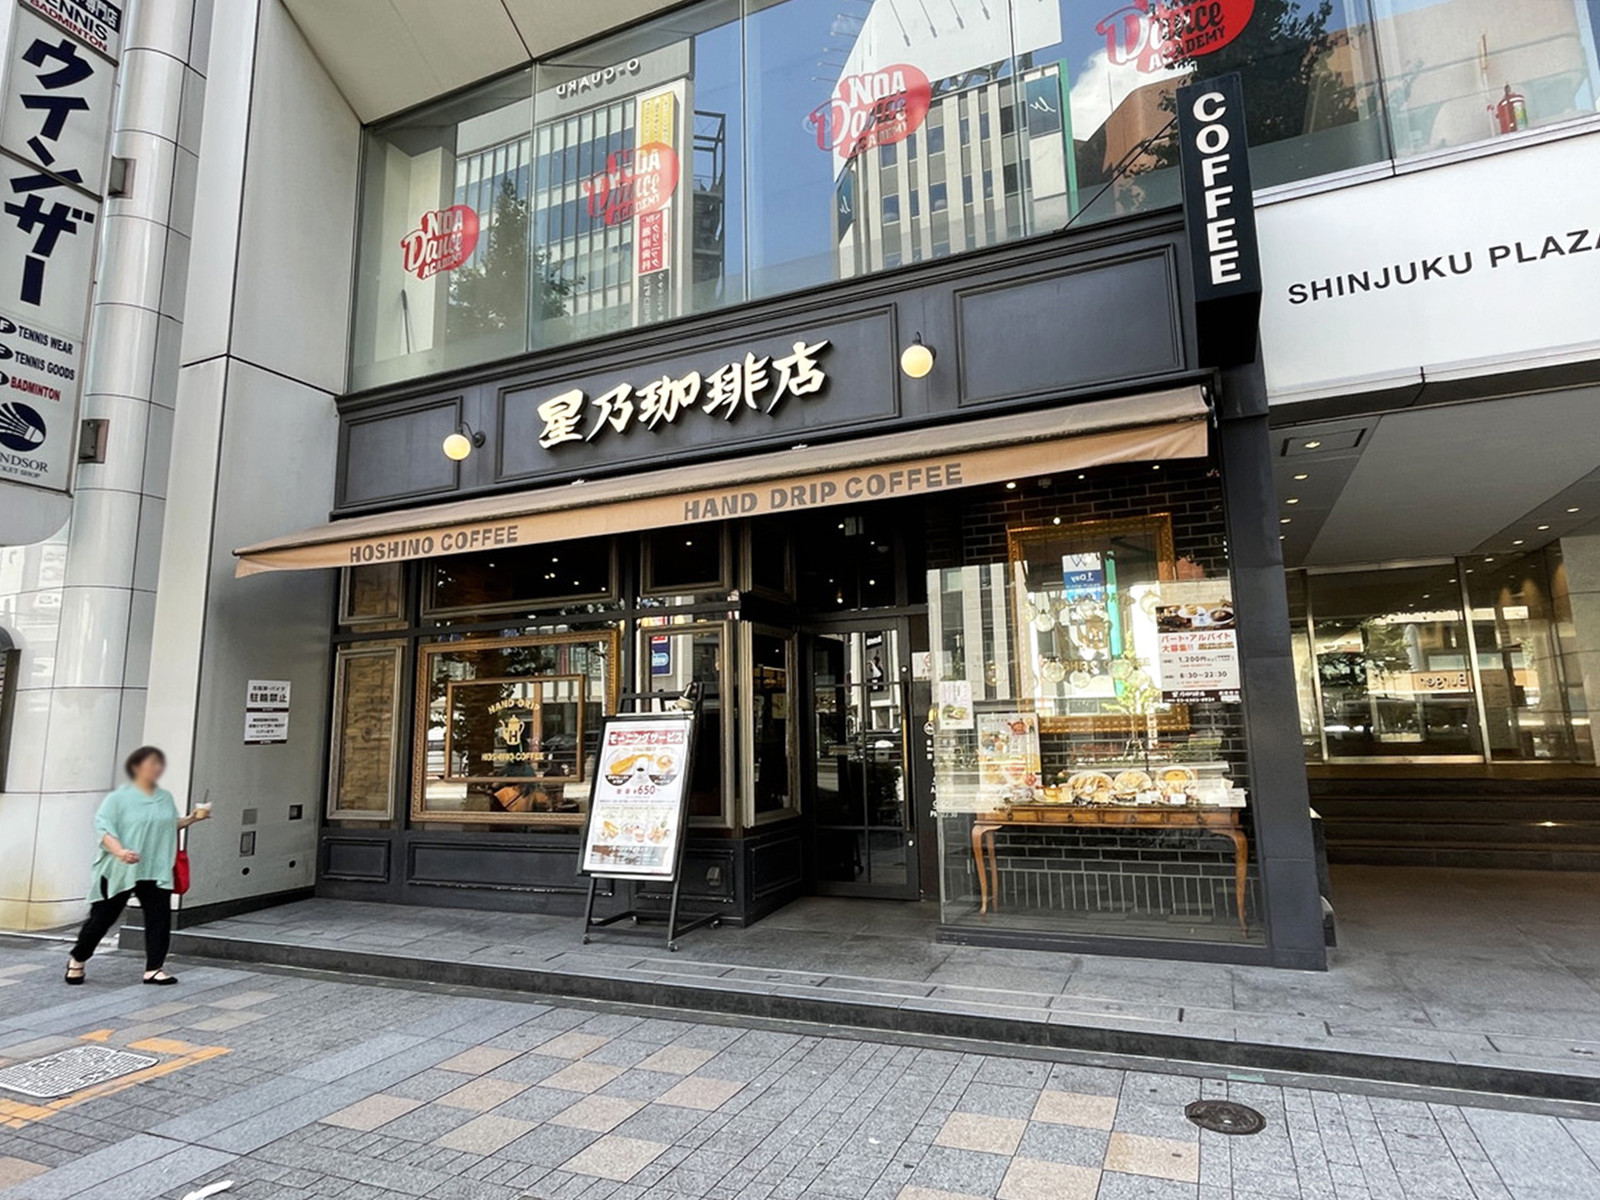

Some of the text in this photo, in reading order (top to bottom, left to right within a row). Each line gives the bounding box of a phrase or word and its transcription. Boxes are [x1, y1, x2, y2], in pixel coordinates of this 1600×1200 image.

[4, 38, 95, 307] ウインザー
[1192, 91, 1241, 285] COFFEE
[426, 209, 464, 238] NOA
[1288, 229, 1600, 304] SHINJUKU PLAZ
[18, 325, 73, 355] TENNIS WEAR
[15, 351, 75, 380] TENNIS GOODS
[10, 376, 61, 401] BADMINTON
[536, 340, 830, 450] 星乃珈琲店
[0, 451, 48, 474] NDSOR
[684, 463, 963, 521] HAND DRIP COFFEE
[350, 525, 518, 563] HOSHINO COFFEE
